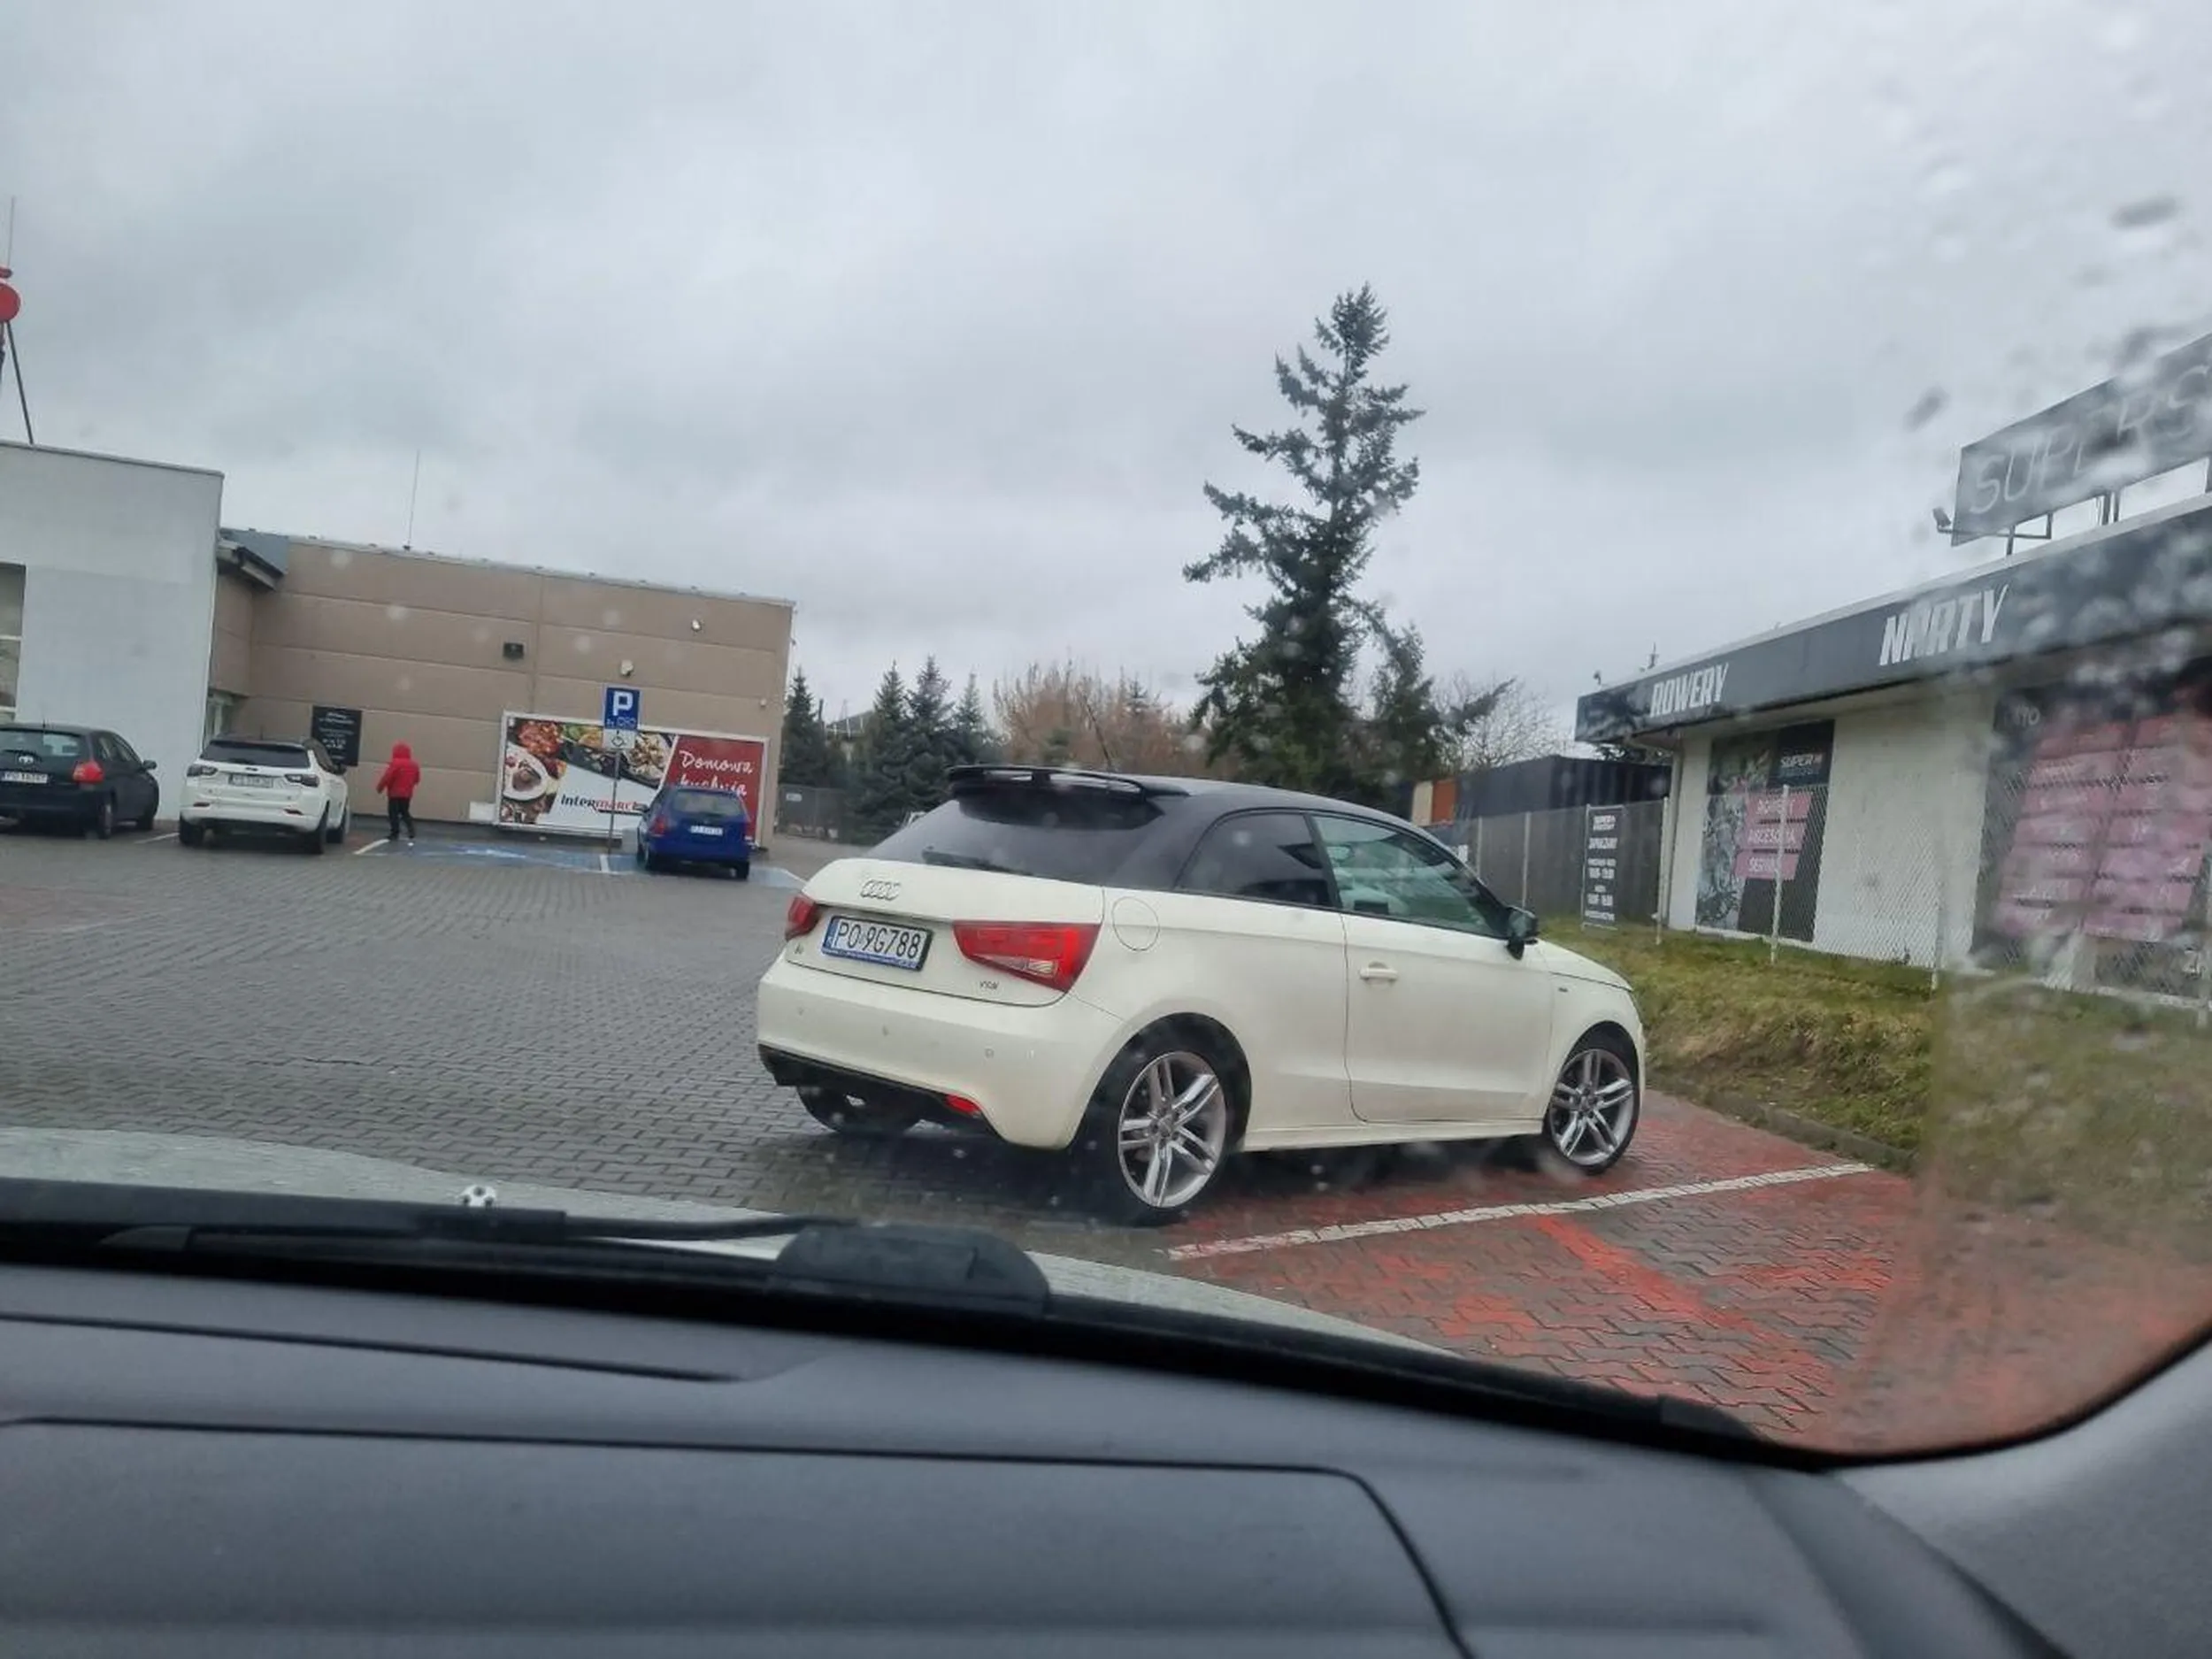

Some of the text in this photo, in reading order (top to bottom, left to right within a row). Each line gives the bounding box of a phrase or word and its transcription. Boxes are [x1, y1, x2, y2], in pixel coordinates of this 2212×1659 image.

[1650, 584, 2008, 718] ROWERY NARTY
[612, 690, 634, 717] P
[679, 750, 753, 773] Domowa
[680, 773, 747, 795] khia
[561, 795, 648, 815] Intermarc
